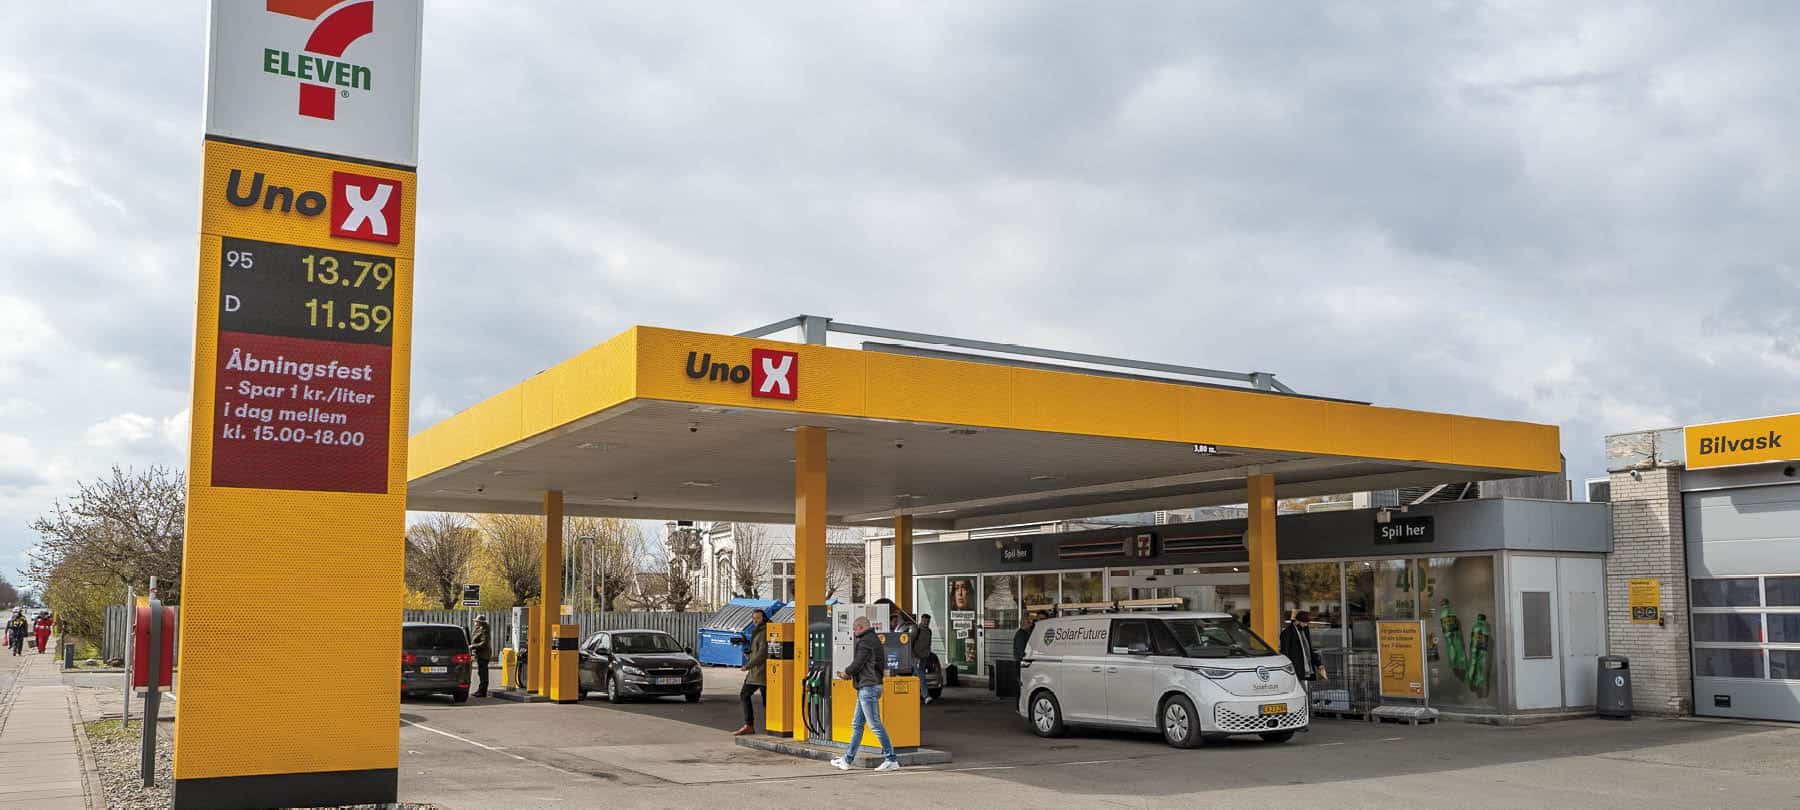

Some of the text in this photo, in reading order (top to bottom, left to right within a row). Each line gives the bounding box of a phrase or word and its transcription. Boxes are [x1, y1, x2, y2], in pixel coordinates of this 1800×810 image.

[225, 168, 394, 236] Uno X
[226, 250, 393, 291] 95 13.79
[225, 294, 392, 333] D 11.59
[226, 347, 373, 382] Åbningsfest
[686, 351, 793, 395] Uno X
[238, 380, 285, 399] Spar
[290, 384, 299, 399] 1
[303, 385, 376, 405] kr./liter
[223, 402, 347, 425] i dag mellem
[223, 424, 365, 447] kl. 15.00-18.00
[1699, 430, 1783, 455] Bilvask
[1381, 524, 1426, 540] Spil her
[1055, 626, 1107, 641] SolarFuture
